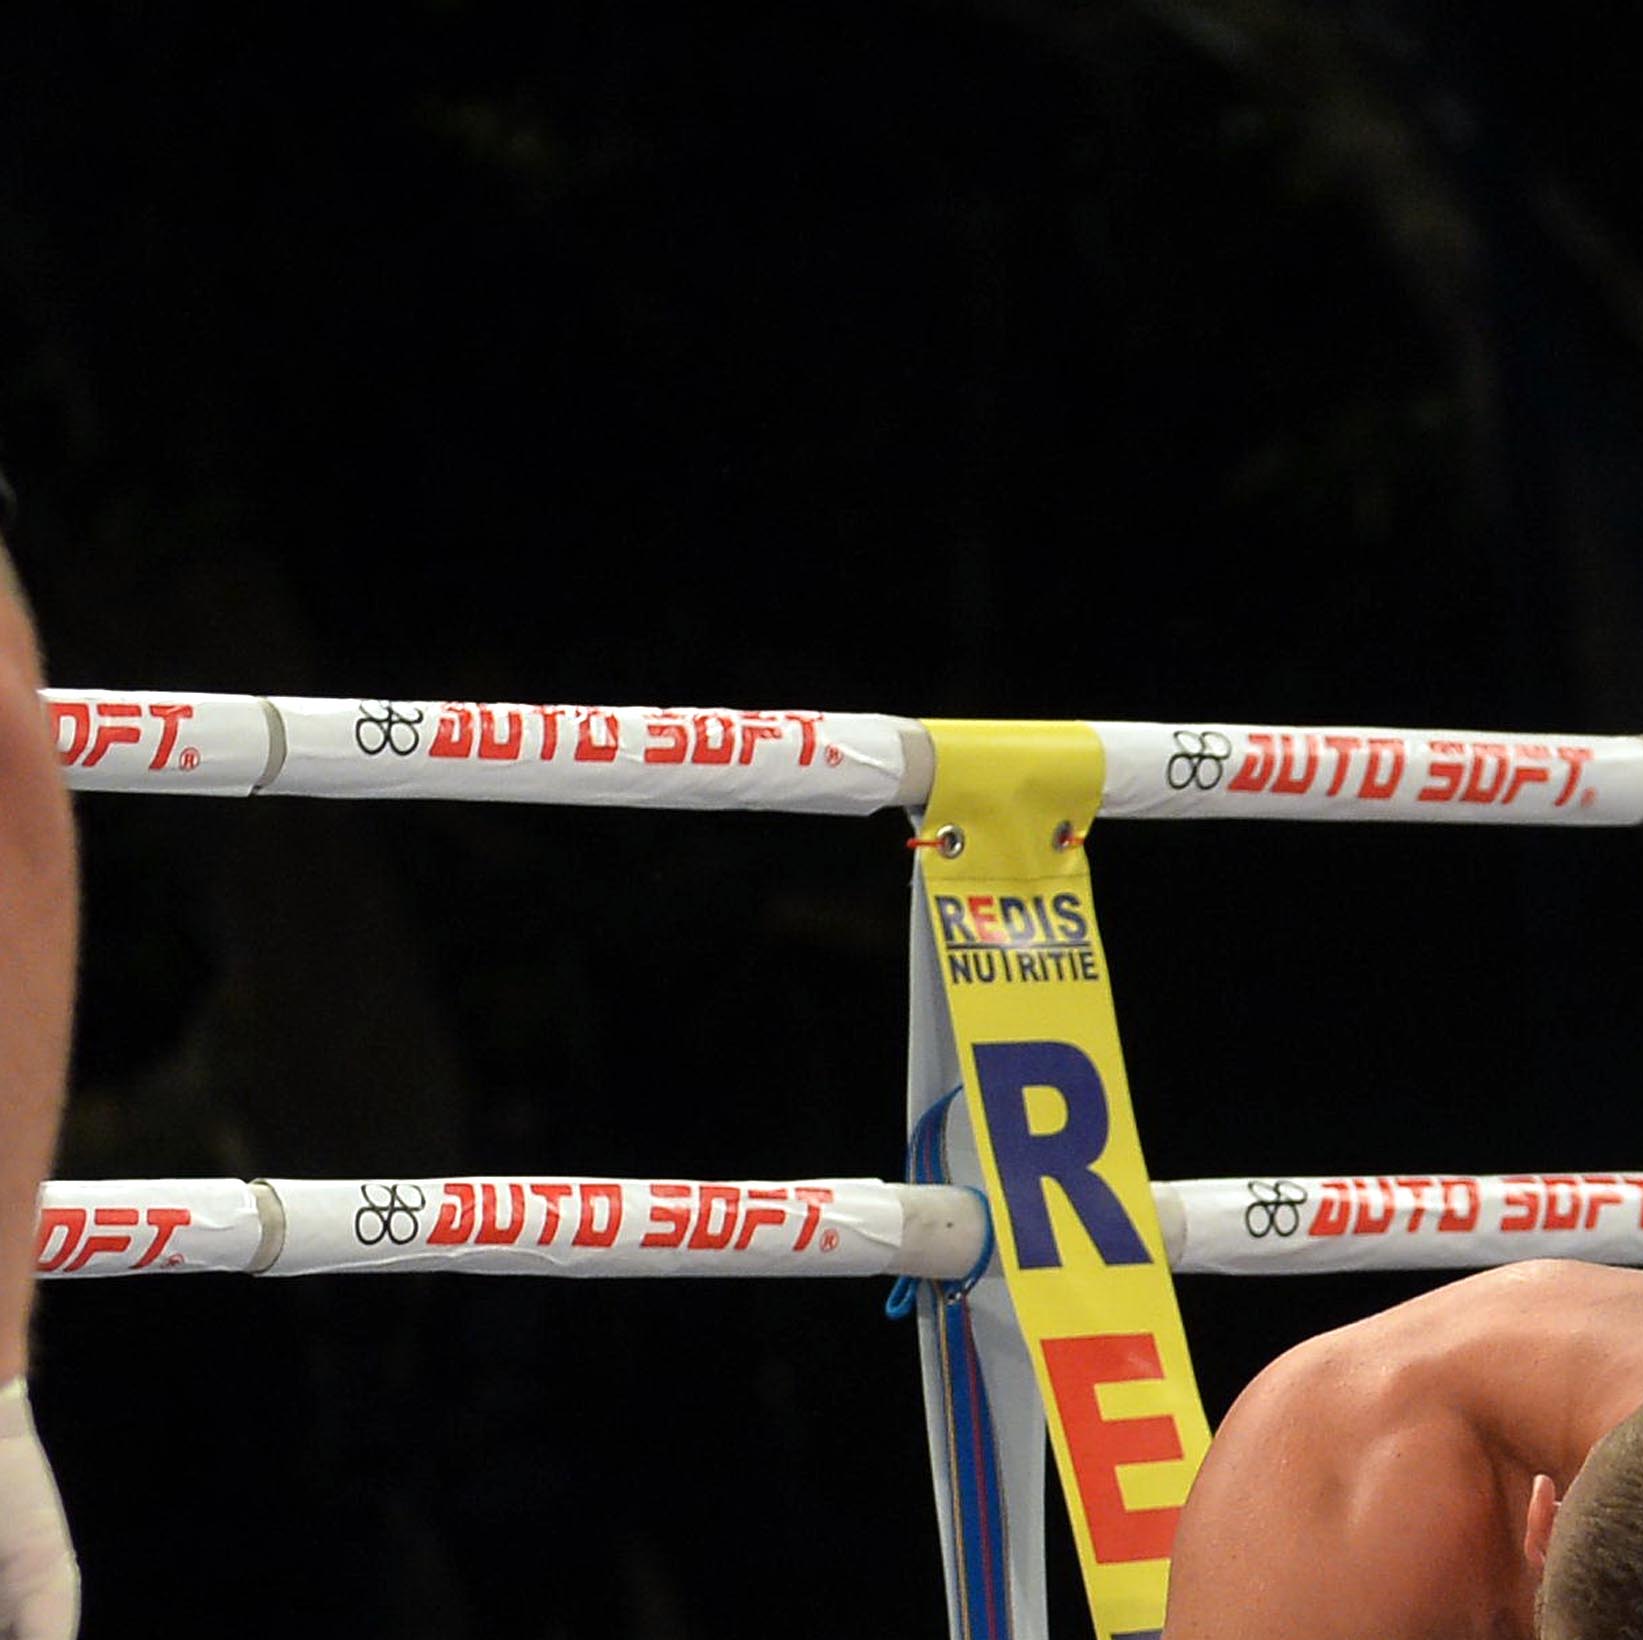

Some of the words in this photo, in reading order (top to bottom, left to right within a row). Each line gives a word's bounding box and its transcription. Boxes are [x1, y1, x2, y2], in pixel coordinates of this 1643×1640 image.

[50, 702, 193, 770] OFT
[428, 702, 620, 760] AUTO
[643, 704, 824, 765] SOFT
[1228, 733, 1403, 796] AUTO
[1418, 738, 1596, 806] SOFT
[934, 892, 1089, 946] REDIS
[949, 949, 1099, 986] NUTRITIE
[427, 1182, 624, 1248] AUTO
[640, 1187, 834, 1252] SOFT
[1308, 1177, 1481, 1237] AUTO
[36, 1207, 191, 1273] OFT
